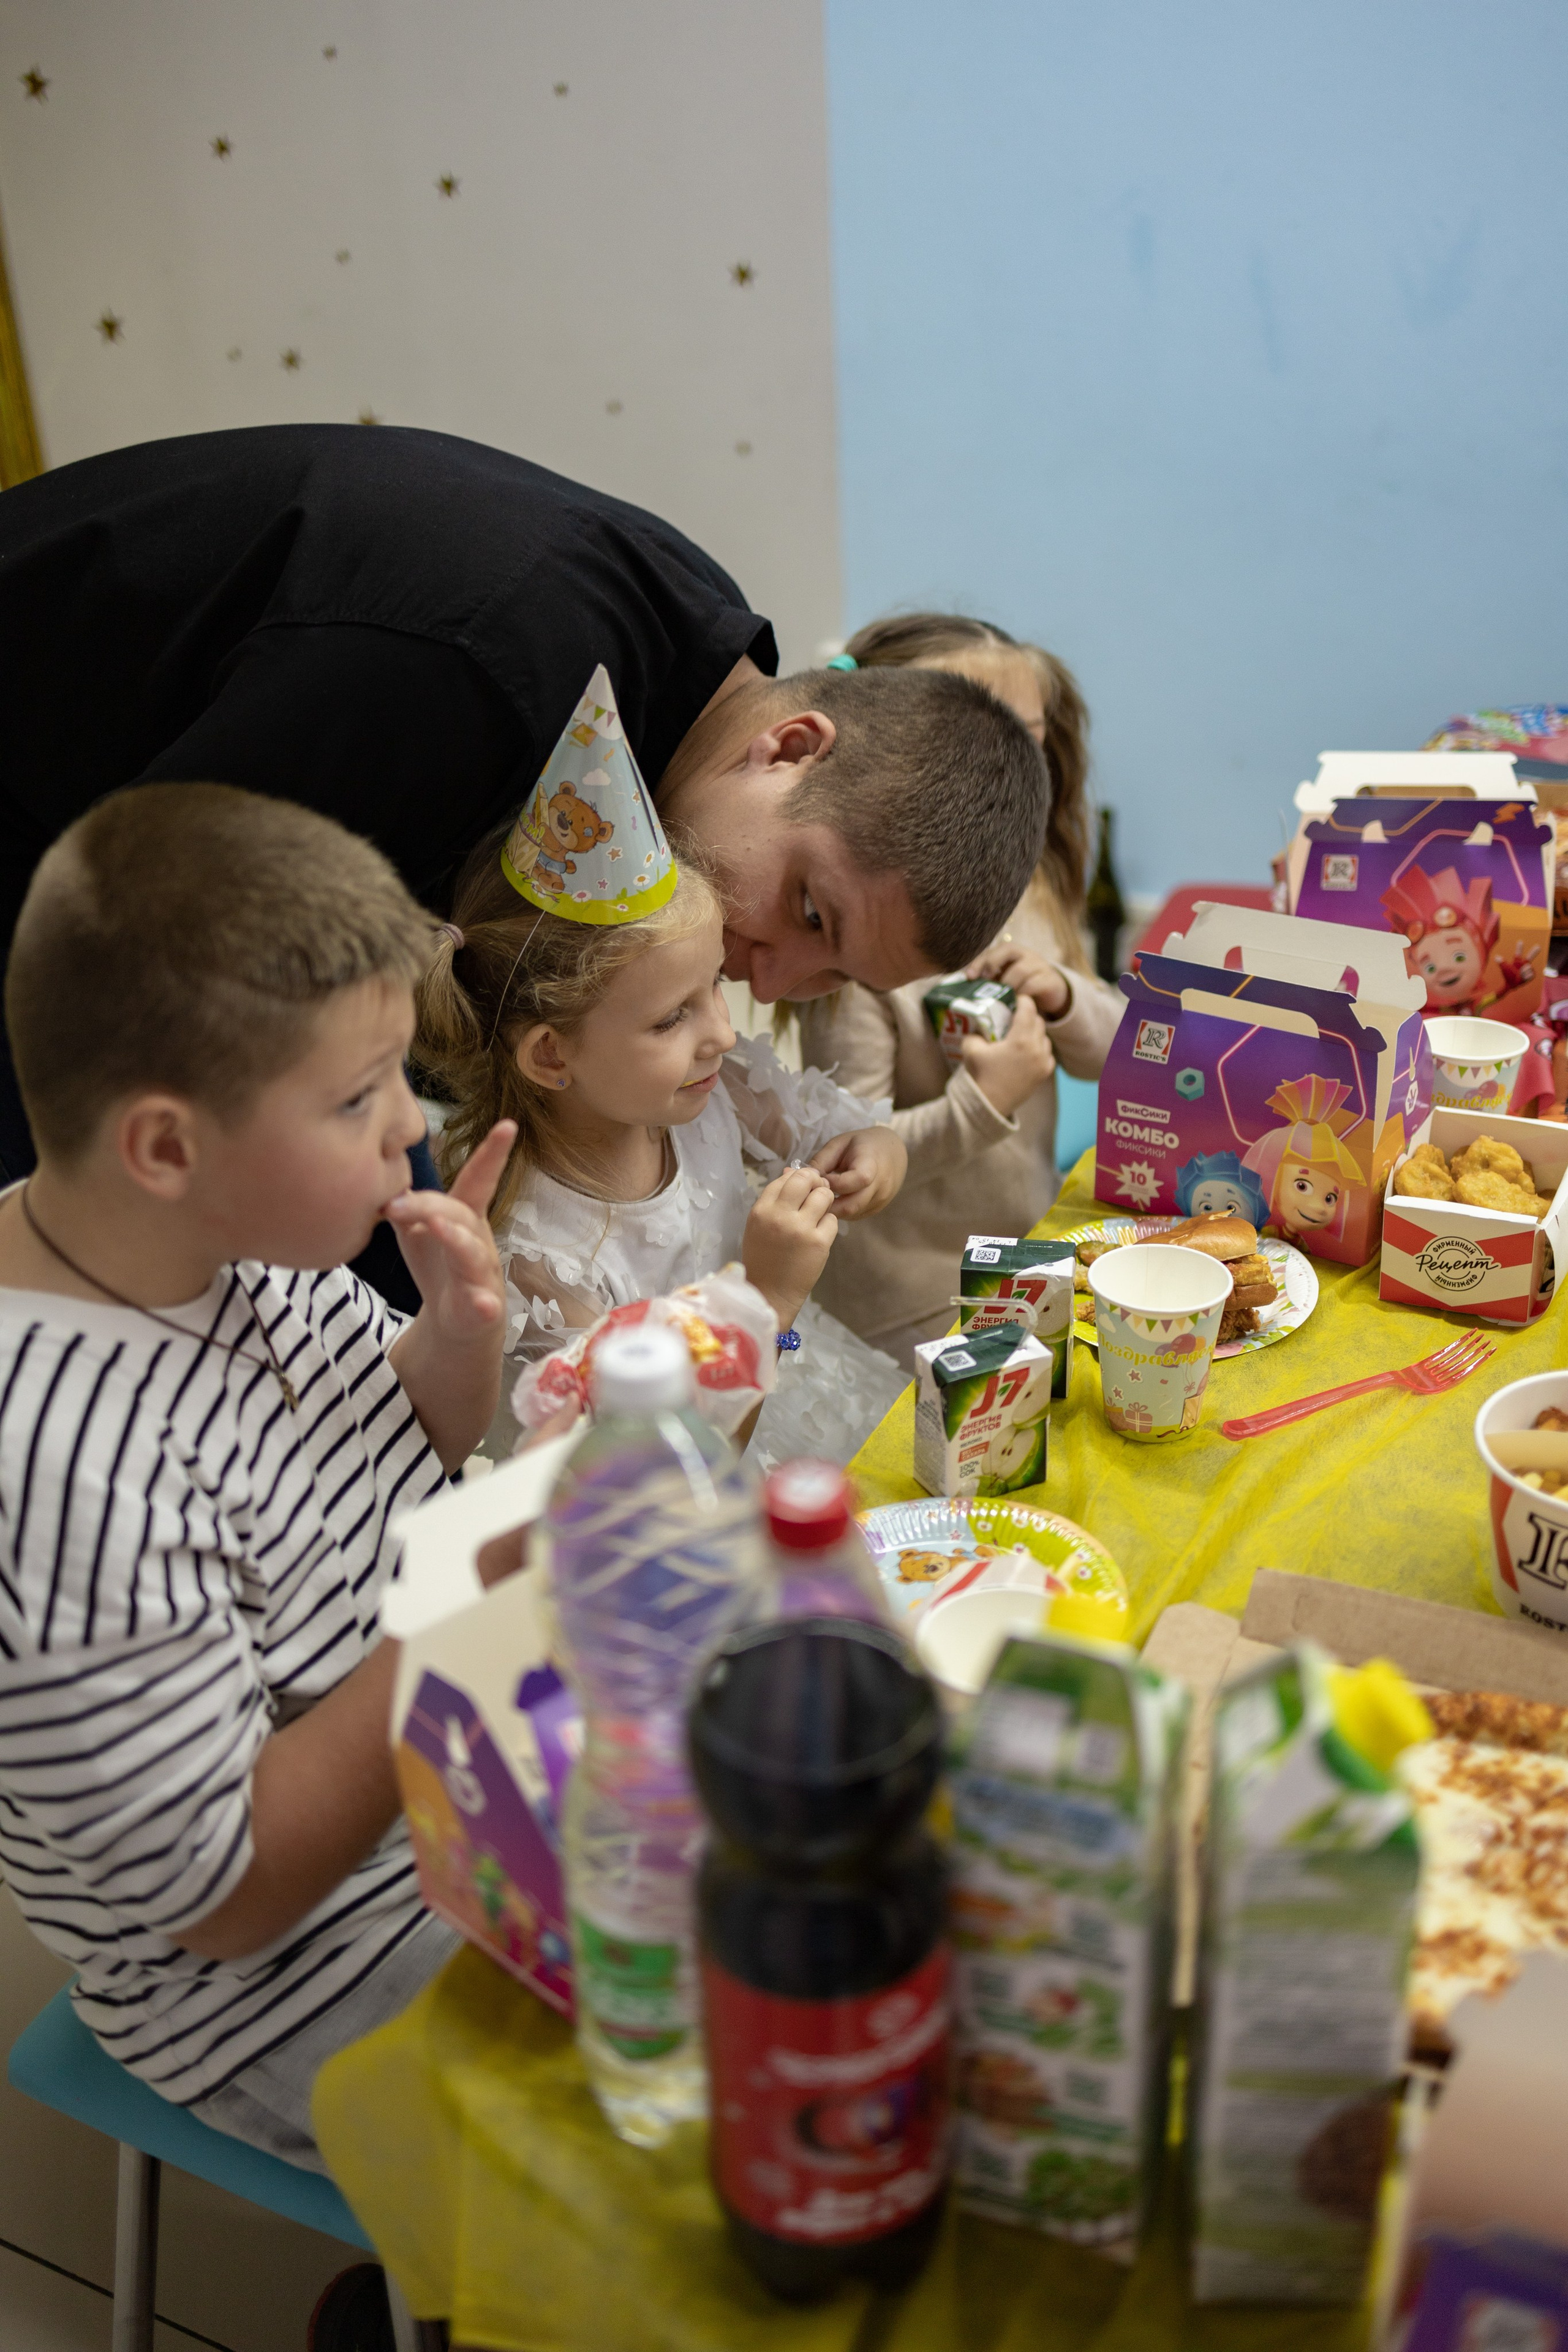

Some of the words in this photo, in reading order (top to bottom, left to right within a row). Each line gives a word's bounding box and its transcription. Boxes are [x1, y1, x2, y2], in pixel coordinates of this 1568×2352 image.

[1142, 1028, 1166, 1049] R
[1136, 1050, 1166, 1061] ROSTIC'S
[1105, 1117, 1180, 1149] КОМБО
[1116, 1140, 1166, 1159] ФИКСИКИ
[1131, 1171, 1147, 1186] 10
[1433, 1240, 1476, 1255] ФИРМЕННЫЙ
[1415, 1254, 1499, 1273] Рецепт
[1434, 1275, 1477, 1287] ФИРМЕННЫЙ
[984, 1278, 1047, 1314] J7
[970, 1366, 1030, 1419] J7
[960, 1422, 1001, 1441] ФРУКТОВ
[961, 1414, 1001, 1433] ЭНЕРГИЯ
[960, 1461, 979, 1472] 100%
[960, 1468, 975, 1478] СОК
